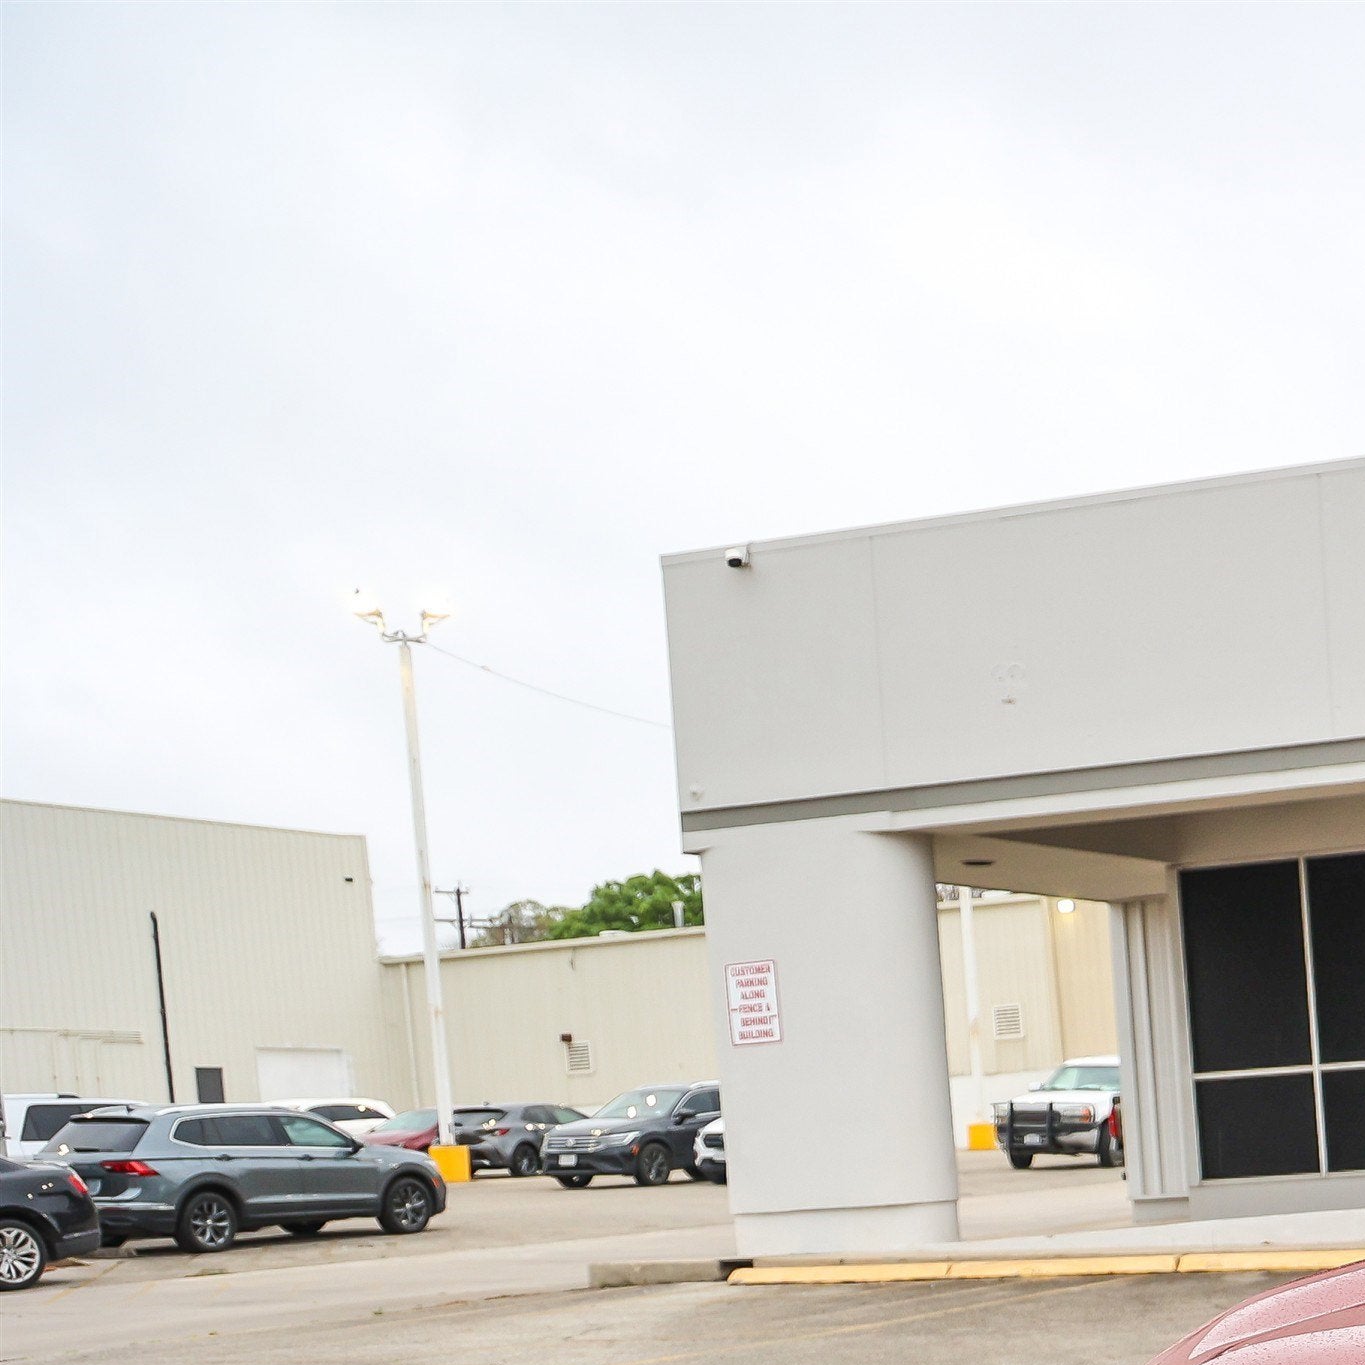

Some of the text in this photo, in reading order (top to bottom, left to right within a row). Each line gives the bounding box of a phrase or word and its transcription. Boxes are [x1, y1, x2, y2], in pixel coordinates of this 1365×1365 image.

[730, 964, 771, 977] CUSTOMER
[735, 976, 768, 988] PARKING
[740, 989, 765, 1000] ALONG
[738, 1003, 763, 1013] FENCE
[740, 1016, 768, 1027] BEHIND
[738, 1028, 774, 1040] BUILDING
